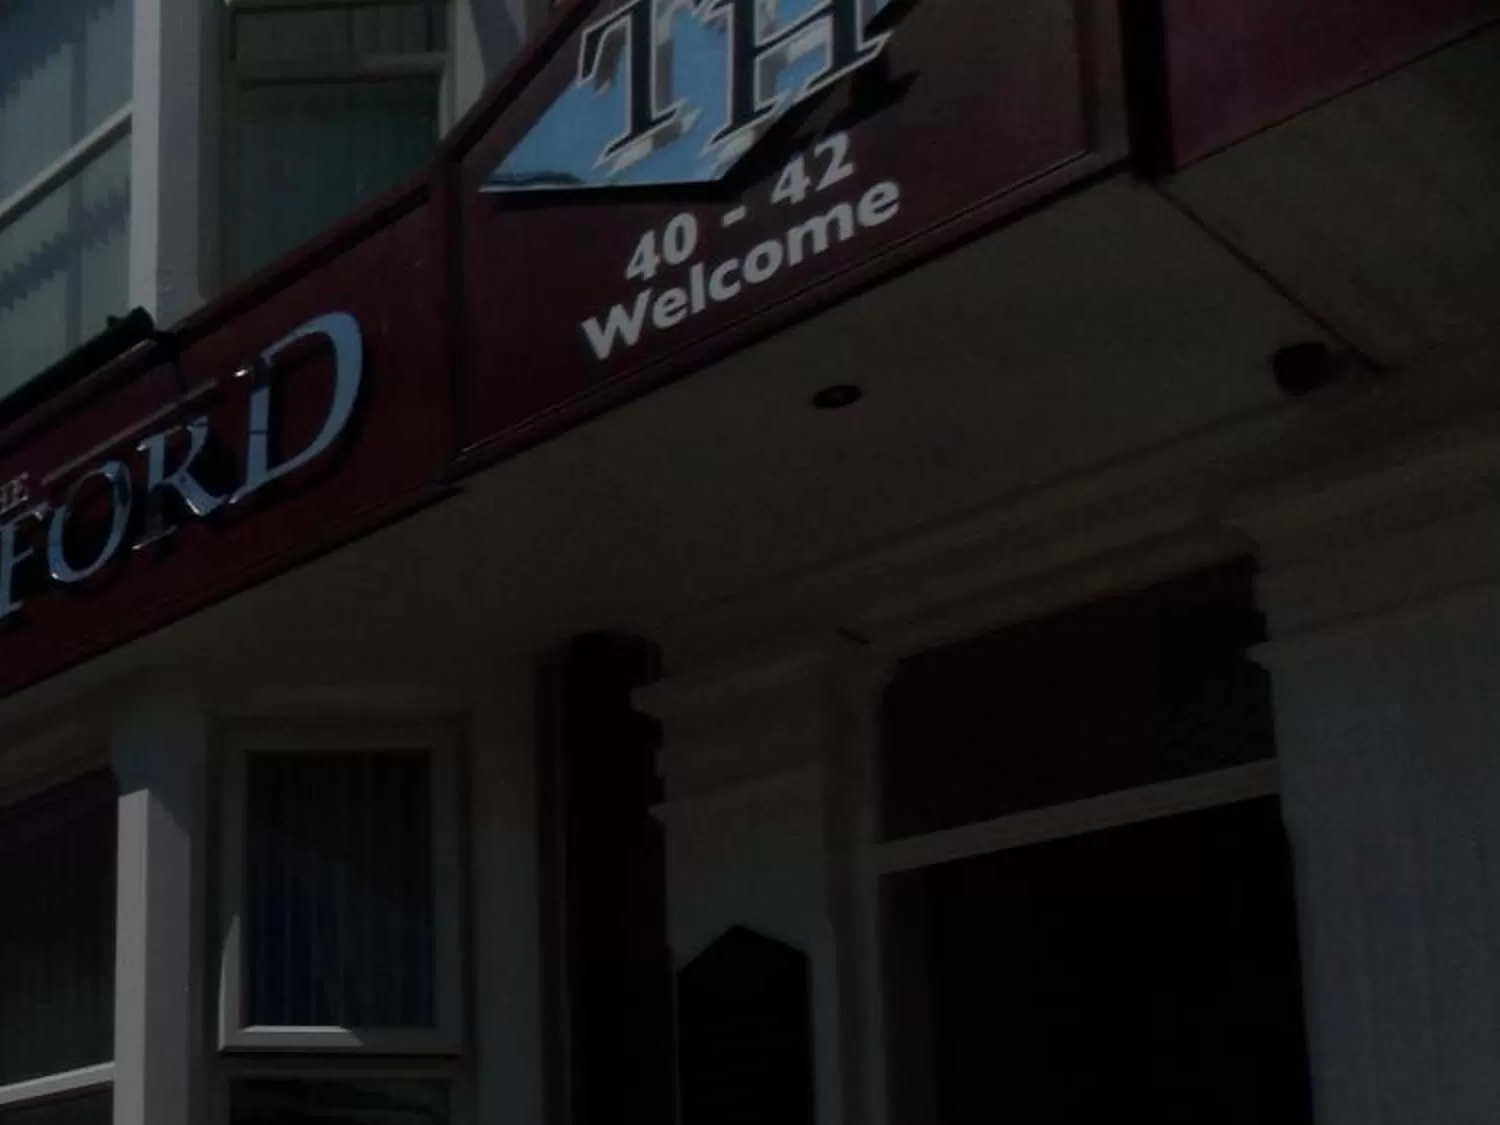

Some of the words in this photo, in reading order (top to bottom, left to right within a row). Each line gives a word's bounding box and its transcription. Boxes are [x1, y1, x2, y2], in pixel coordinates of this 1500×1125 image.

[579, 177, 905, 363] Welcome
[624, 211, 700, 284] 40
[770, 132, 859, 208] 42
